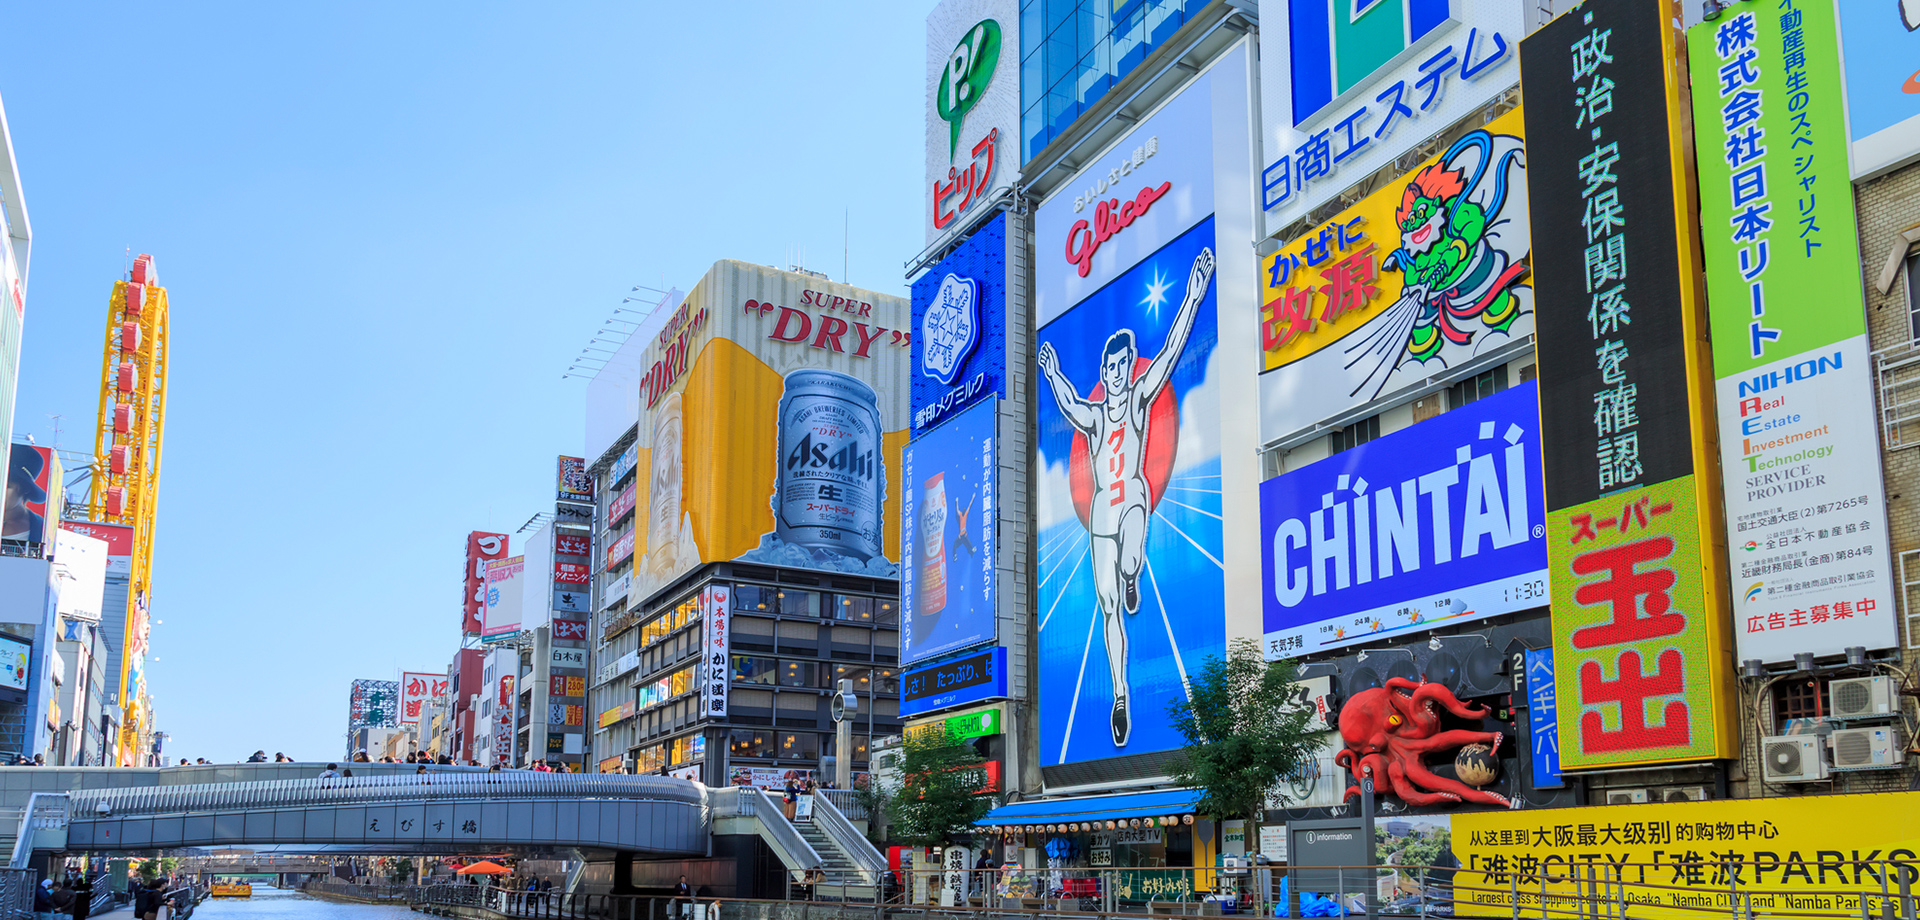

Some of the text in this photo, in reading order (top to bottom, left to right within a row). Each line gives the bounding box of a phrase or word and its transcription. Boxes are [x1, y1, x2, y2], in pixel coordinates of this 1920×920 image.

[1262, 27, 1509, 212] 日商エステム
[933, 127, 998, 229] ピップ
[1073, 136, 1158, 213] おいしさと健康
[1715, 12, 1782, 358] 株式会社日本リート
[1065, 181, 1172, 278] Glico
[1268, 216, 1366, 288] かぜに
[1568, 0, 1644, 490] ・政治・安保関係を確認
[800, 289, 873, 318] SUPER
[1260, 242, 1382, 352] 改源
[659, 303, 688, 350] SUPER
[1738, 351, 1843, 398] NIHON
[915, 372, 985, 430] 雪印メグミルク
[1739, 395, 1785, 417] Real
[1741, 413, 1801, 436] Estate
[1742, 424, 1829, 456] Investment
[787, 432, 873, 481] Asahi
[1107, 421, 1126, 507] グリコ
[1741, 444, 1834, 473] Technology
[1745, 464, 1811, 489] SERVICE
[1747, 474, 1826, 502] PROVIDER
[818, 484, 843, 502] 生
[806, 503, 855, 517] スーパードライ
[1570, 496, 1673, 545] スーパー
[820, 530, 841, 540] 350ml
[1766, 520, 1871, 550] 全日本不動産協会
[555, 571, 589, 582] ダイニング
[1434, 598, 1450, 608] 12時
[1505, 580, 1544, 603] 11:30
[1354, 616, 1370, 626] 24時
[1397, 608, 1409, 617] 6時
[1747, 597, 1876, 634] 広告主募集中
[1319, 625, 1334, 634] 18時
[553, 650, 583, 663] 白木屋
[1270, 635, 1303, 655] 天気予報
[1570, 535, 1692, 756] 玉出
[1512, 653, 1524, 692] 2F
[407, 678, 448, 698] かに
[494, 704, 514, 767] 大阪王
[369, 819, 477, 834] えびす橋
[1317, 832, 1353, 841] information
[1469, 820, 1779, 848] 从这里到大阪最大级别的购物中心
[1471, 891, 1505, 905] Largest
[1507, 891, 1531, 904] cass
[1752, 893, 1775, 908] and
